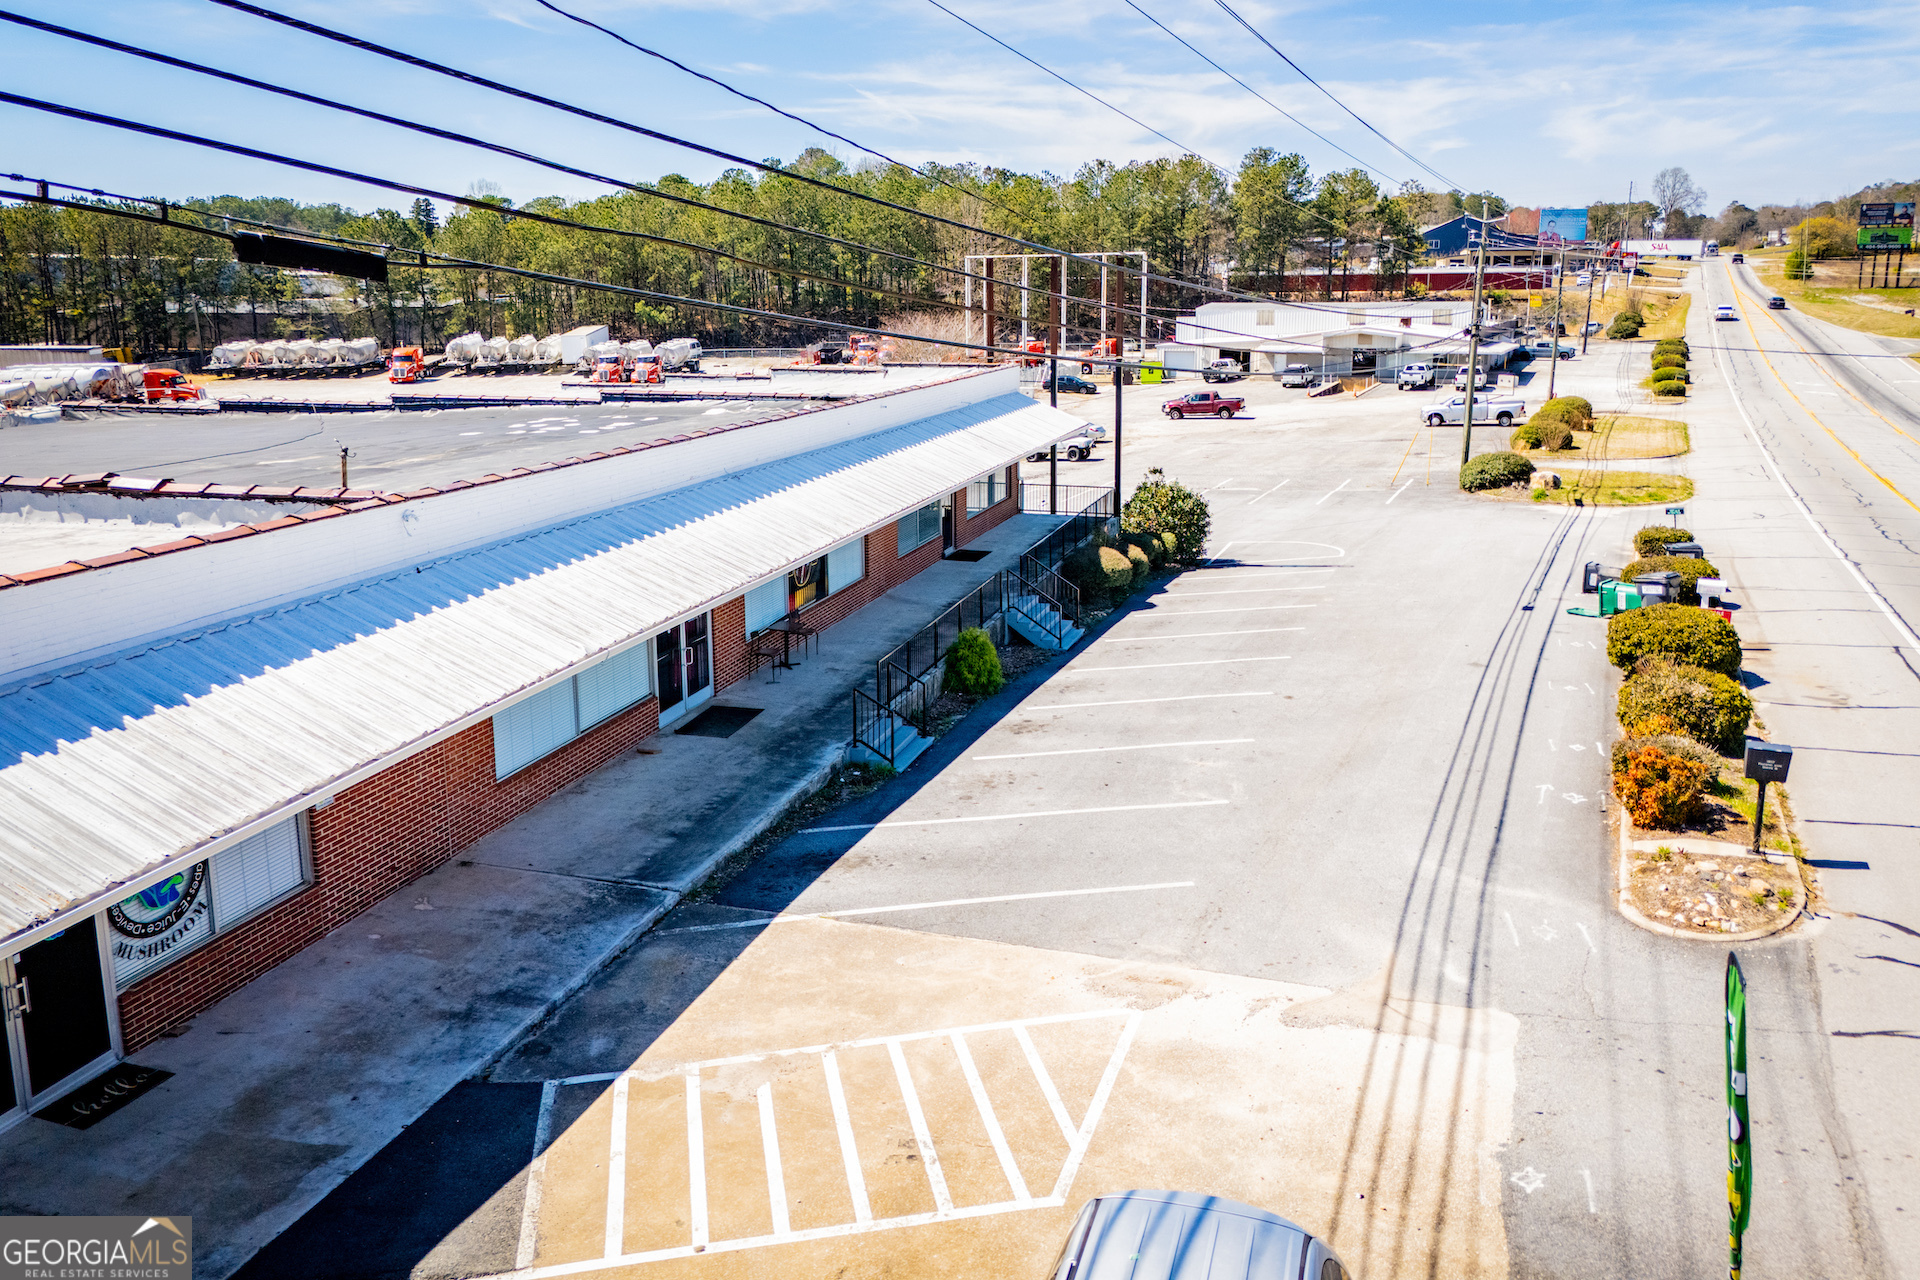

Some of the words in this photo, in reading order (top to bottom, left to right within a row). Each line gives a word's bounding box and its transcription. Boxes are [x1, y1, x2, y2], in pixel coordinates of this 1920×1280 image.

[188, 862, 204, 895] apes
[113, 900, 209, 961] MUSHROOM
[146, 899, 190, 934] E-Juice
